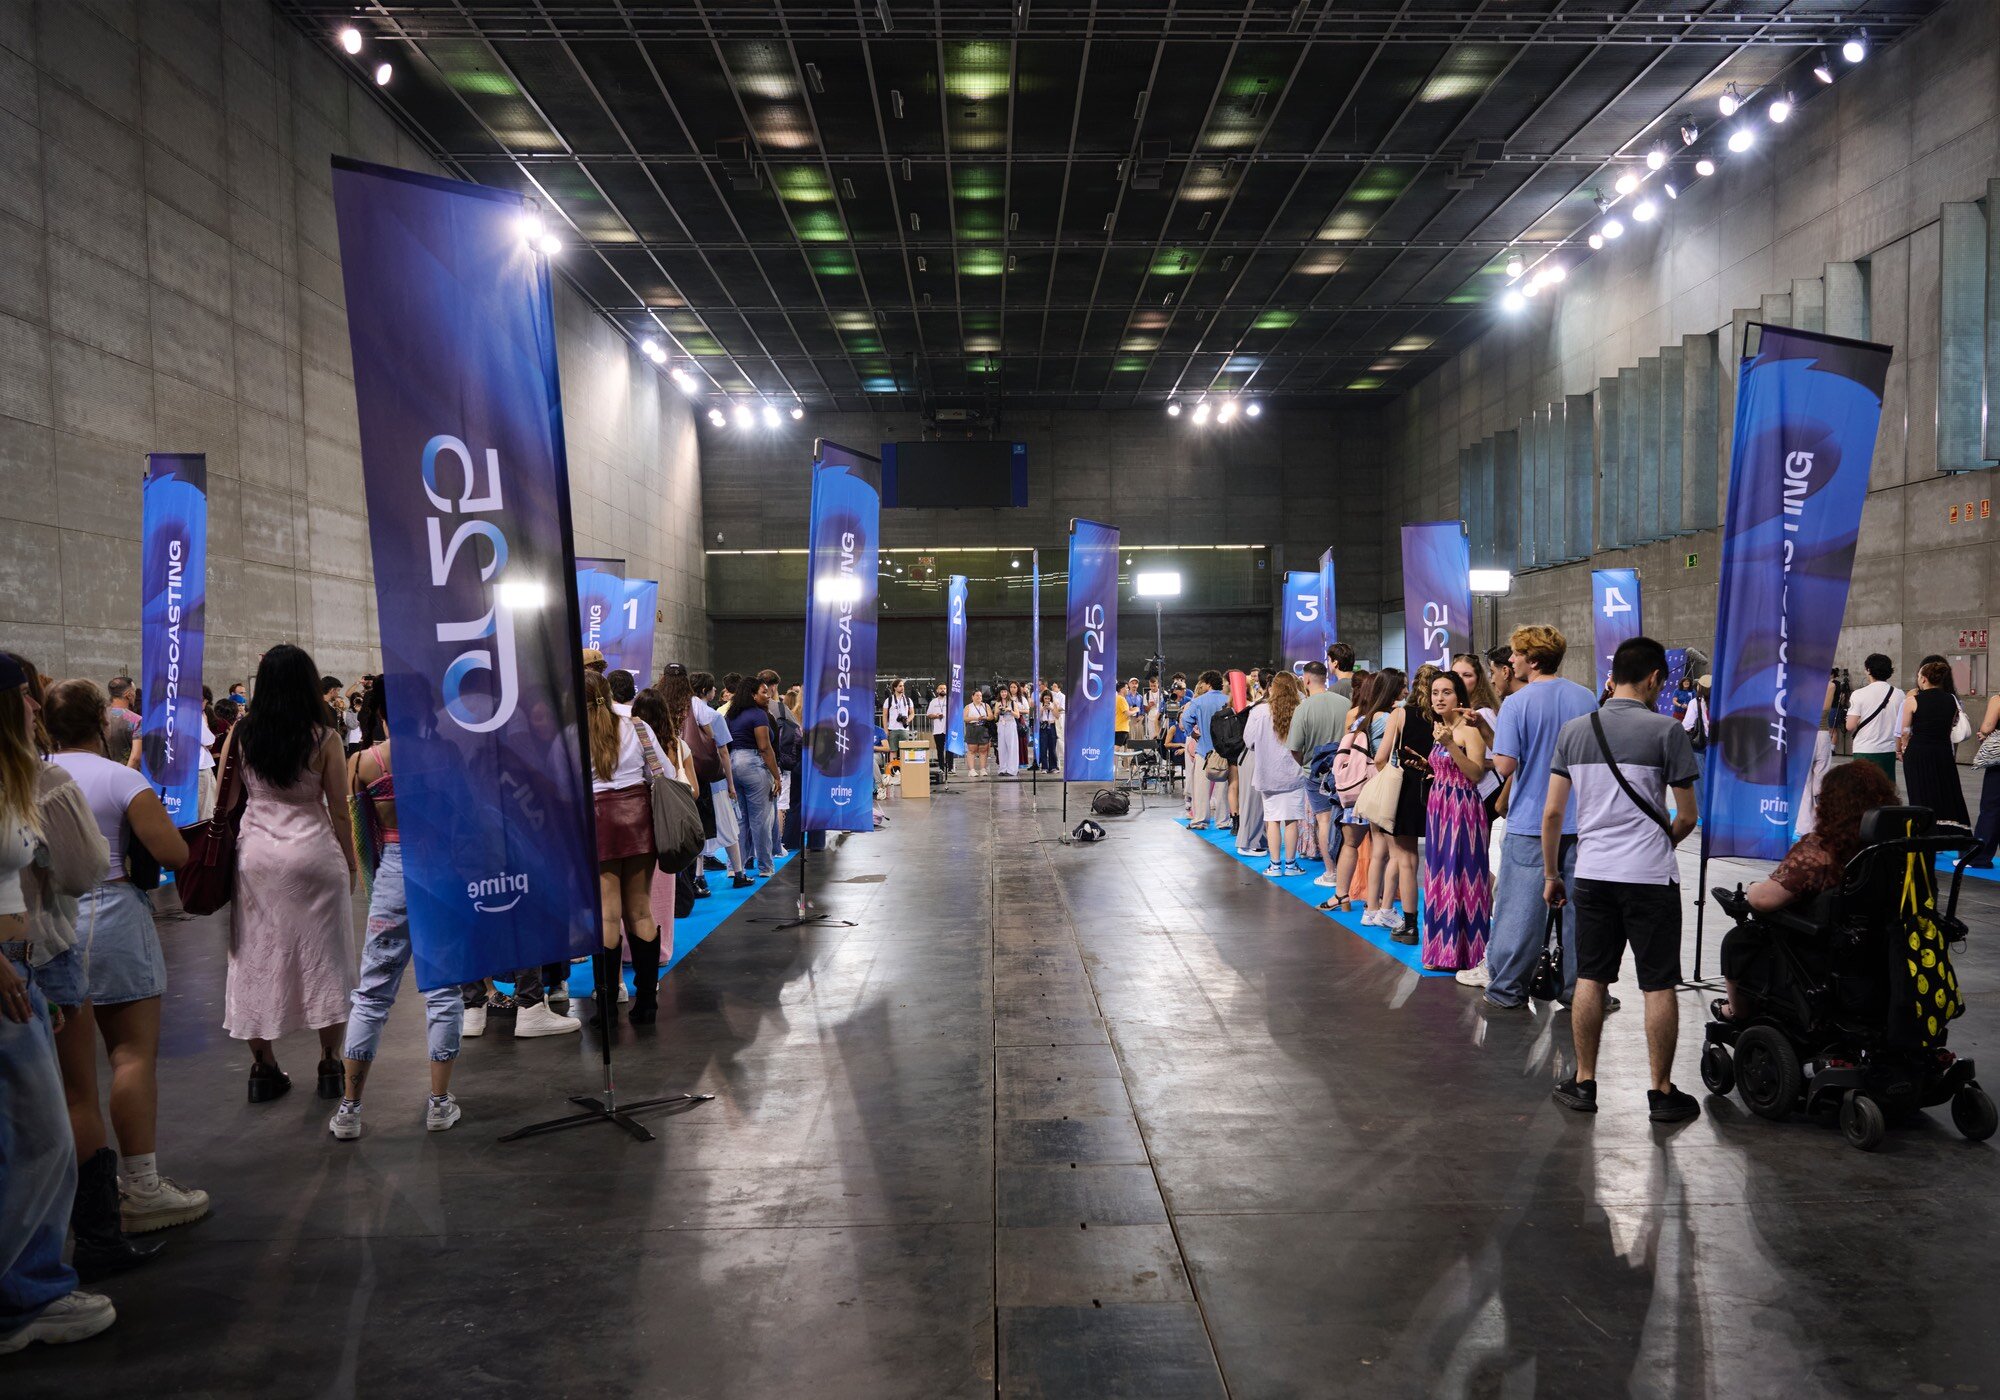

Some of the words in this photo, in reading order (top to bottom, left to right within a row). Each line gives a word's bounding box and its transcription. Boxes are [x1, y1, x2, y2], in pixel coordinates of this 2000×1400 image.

[623, 598, 638, 630] 1
[953, 595, 962, 625] 2
[1296, 595, 1319, 622] 3
[166, 540, 183, 765] #OT25CASTING
[1082, 603, 1105, 701] OT25
[1082, 746, 1101, 757] prime
[831, 785, 853, 799] prime
[1760, 796, 1789, 814] prim
